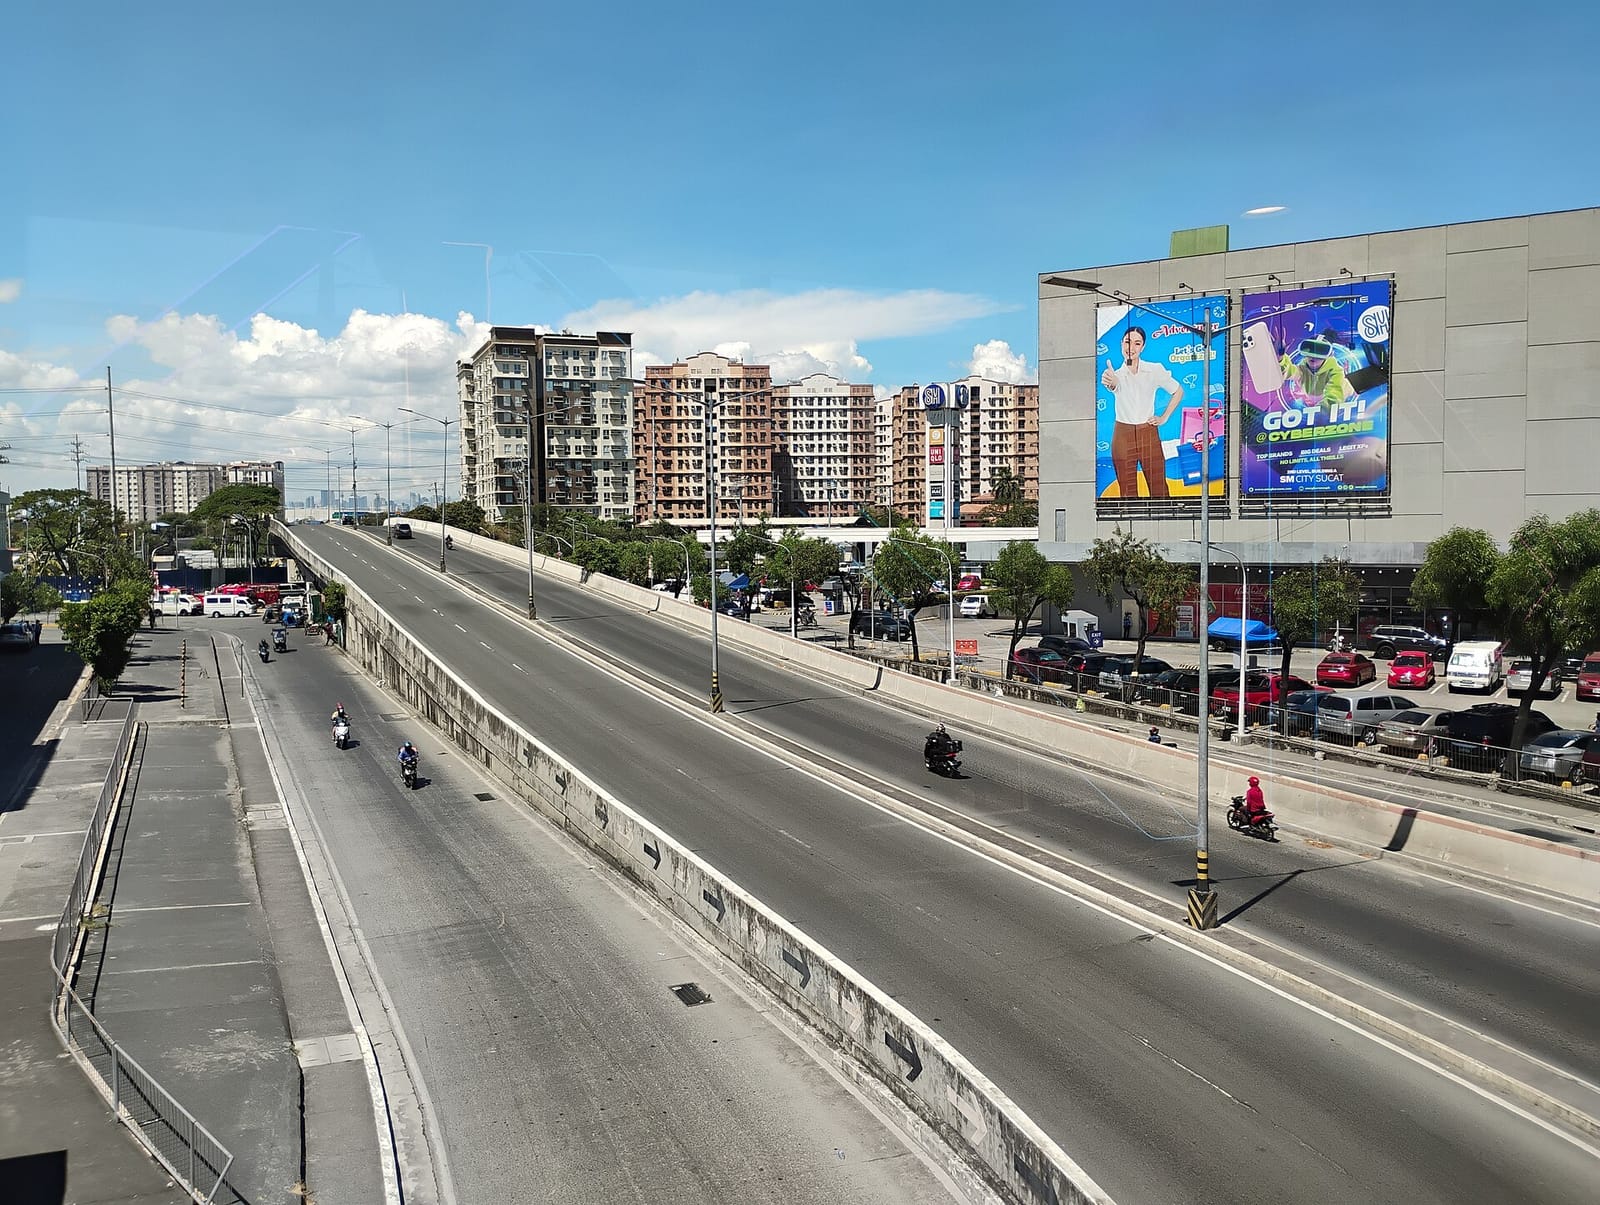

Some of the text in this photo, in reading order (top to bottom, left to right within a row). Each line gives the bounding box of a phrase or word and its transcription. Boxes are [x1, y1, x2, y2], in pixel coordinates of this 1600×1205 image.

[1261, 296, 1369, 313] CYBEONE
[1361, 308, 1390, 340] SM
[924, 387, 941, 406] SM
[1263, 400, 1366, 431] GOT IT!
[1269, 451, 1293, 459] BRANDS
[1280, 473, 1344, 483] SM CITY SUCAT
